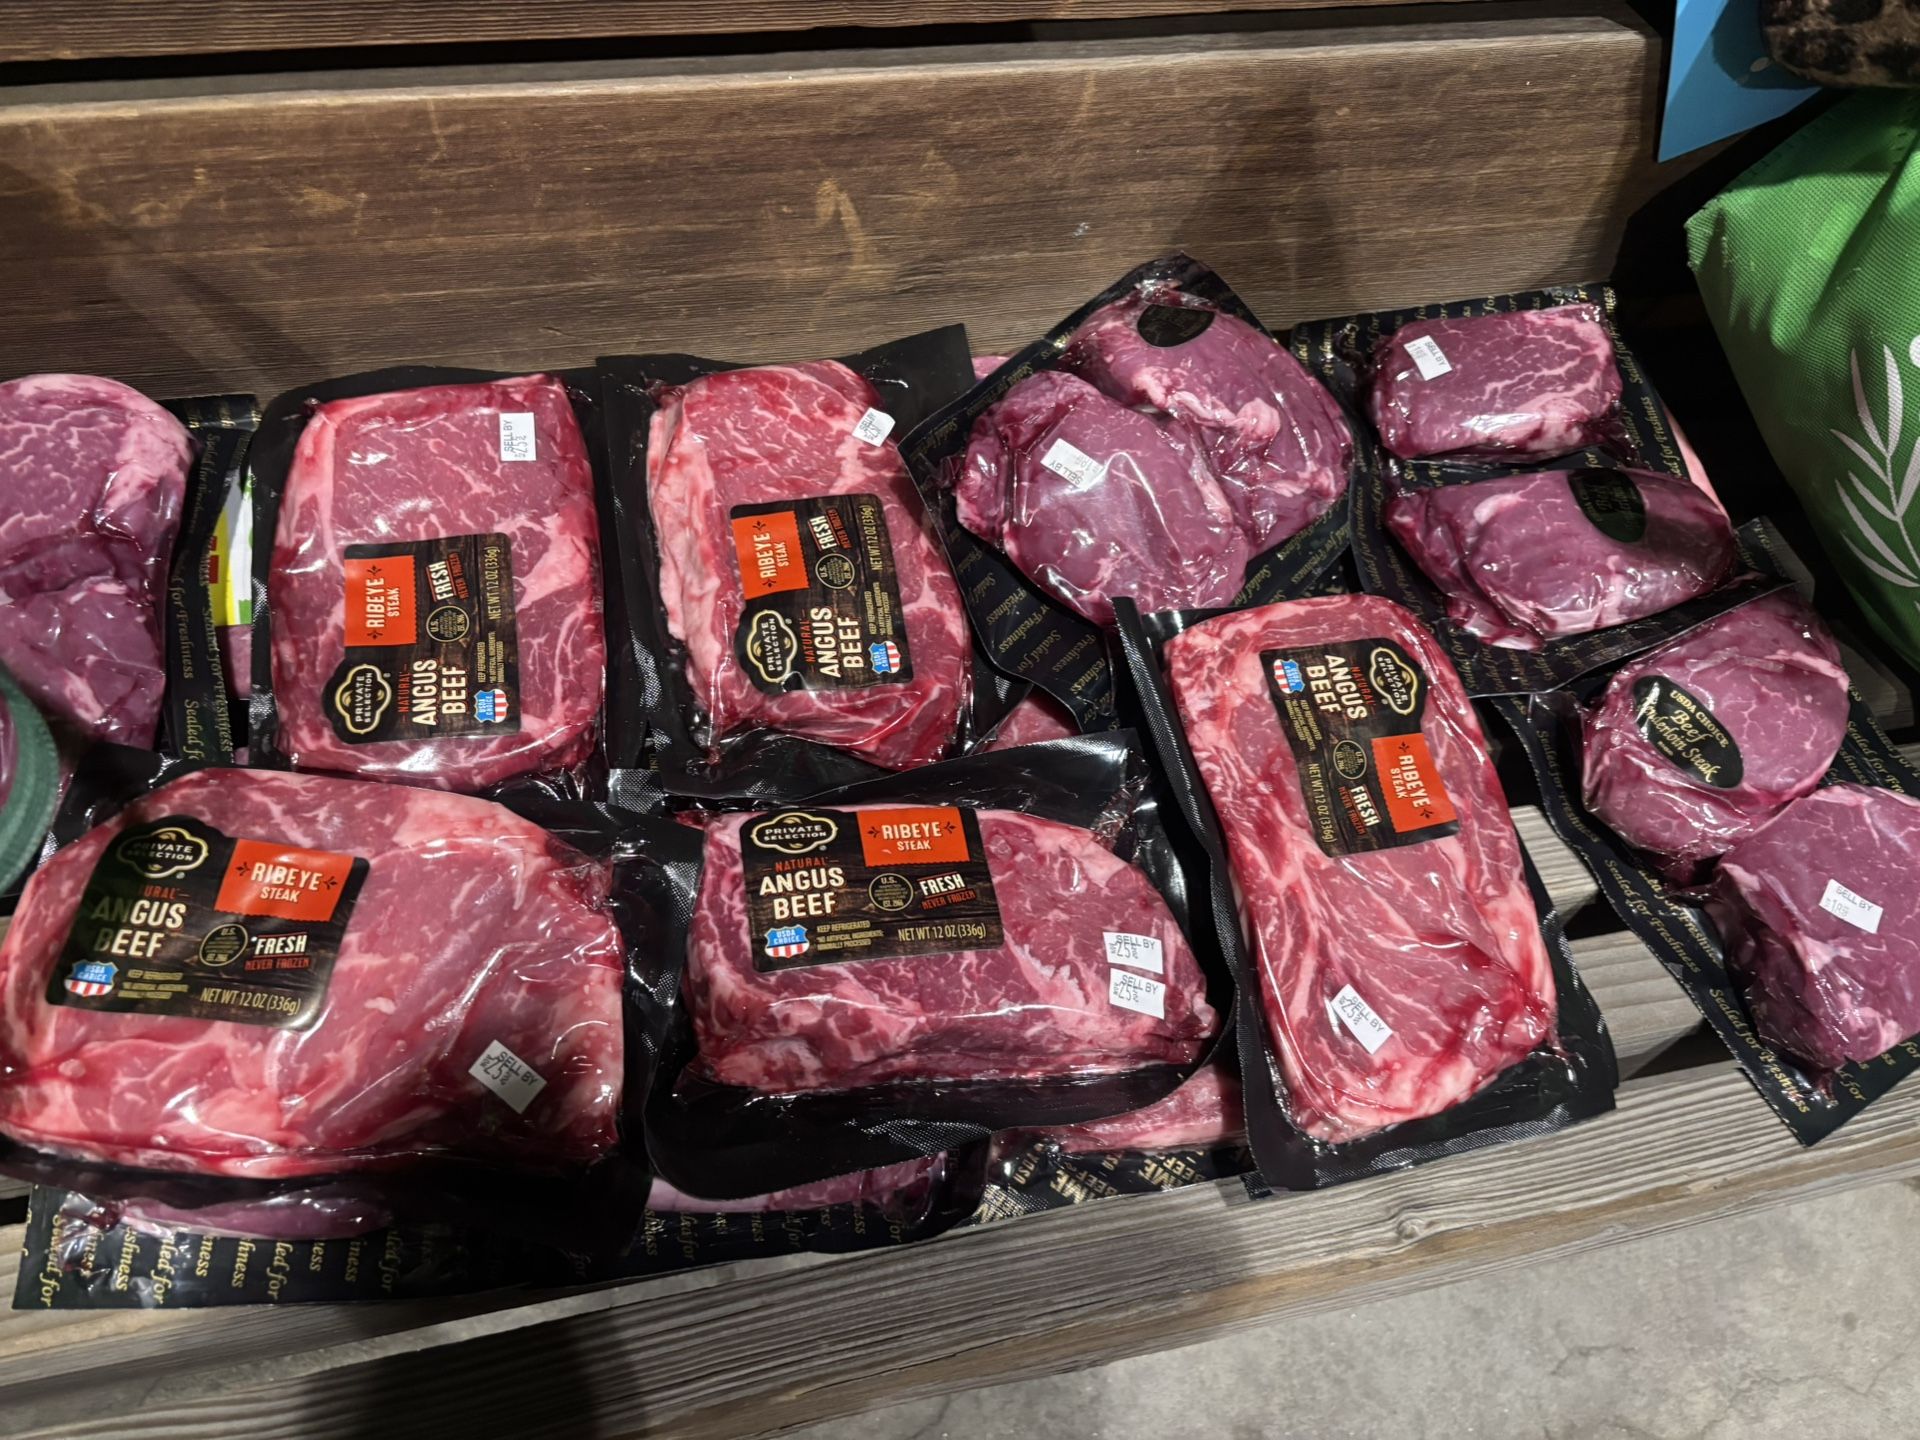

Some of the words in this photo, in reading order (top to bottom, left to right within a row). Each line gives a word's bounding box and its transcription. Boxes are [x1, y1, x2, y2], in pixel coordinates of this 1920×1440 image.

[503, 420, 512, 431] BY
[503, 432, 513, 452] SELL
[1049, 459, 1063, 471] BY
[1063, 466, 1084, 485] SELL
[809, 514, 839, 550] FRESH
[753, 532, 778, 580] RIBEYE
[774, 541, 790, 568] STEAK
[867, 541, 881, 556] WT
[869, 555, 883, 571] NET
[429, 560, 455, 601] FRESH
[486, 587, 500, 603] WT
[365, 577, 385, 629] RIBEYE
[386, 587, 400, 618] STEAK
[489, 602, 501, 620] NET
[761, 621, 776, 672] PRIVATE
[768, 617, 783, 672] SELECTION
[809, 606, 842, 678] ANGUS
[837, 616, 865, 668] BEEF
[411, 658, 438, 726] ANGUS
[441, 665, 467, 715] BEEF
[1305, 665, 1342, 714] BEEF
[1324, 654, 1369, 720] ANGUS
[1376, 656, 1403, 705] SELECTION
[1383, 657, 1409, 702] PRIVATE
[355, 675, 366, 722] PRIVATE
[364, 672, 373, 723] SELECTION
[1669, 689, 1697, 714] USDA
[1695, 710, 1730, 749] CHOICE
[1669, 709, 1714, 743] Beef
[1308, 762, 1321, 780] NET
[1681, 747, 1722, 783] Steak
[1310, 778, 1324, 796] WT
[1389, 768, 1408, 799] STEAK
[1398, 755, 1431, 808] RIBEYE
[1351, 785, 1380, 827] FRESH
[1558, 789, 1600, 843] Freshness
[763, 831, 827, 842] SELECTION
[764, 825, 822, 835] PRIVATE
[881, 821, 942, 841] RIBEYE
[896, 840, 932, 852] STEAK
[250, 862, 324, 892] RIBEYE
[759, 867, 845, 897] ANGUS
[880, 876, 898, 886] U.S.
[919, 874, 966, 897] FRESH
[260, 887, 300, 904] STEAK
[773, 892, 838, 920] BEEF
[920, 897, 947, 911] NEVER
[946, 889, 977, 906] FROZEN
[1858, 900, 1874, 911] BY
[91, 899, 188, 928] ANGUS
[1604, 858, 1640, 903] Sealed
[1650, 915, 1702, 974] Freshness
[94, 928, 166, 958] BEEF
[253, 935, 307, 956] FRESH
[775, 929, 797, 939] USDA
[897, 928, 915, 942] NET
[915, 926, 931, 940] WT
[932, 925, 944, 939] 12
[943, 924, 957, 938] OZ
[957, 923, 987, 939] (336g)
[1115, 934, 1141, 947] SELL
[1142, 939, 1156, 950] BY
[244, 958, 274, 971] NEVER
[275, 957, 311, 970] FROZEN
[1122, 974, 1144, 991] SELL
[1145, 982, 1159, 995] BY
[201, 987, 222, 1002] NET
[221, 989, 240, 1005] WT
[239, 992, 253, 1007] 12
[252, 993, 269, 1009] OZ
[267, 994, 301, 1016] (336g)
[1351, 996, 1371, 1021] SELL
[1369, 1018, 1385, 1033] BY
[1708, 988, 1747, 1030] Sealed
[1735, 1026, 1762, 1052] for
[499, 1051, 522, 1077] SELL
[521, 1071, 539, 1086] BY
[39, 1272, 61, 1308] for
[150, 1269, 173, 1305] for
[266, 1266, 288, 1300] for
